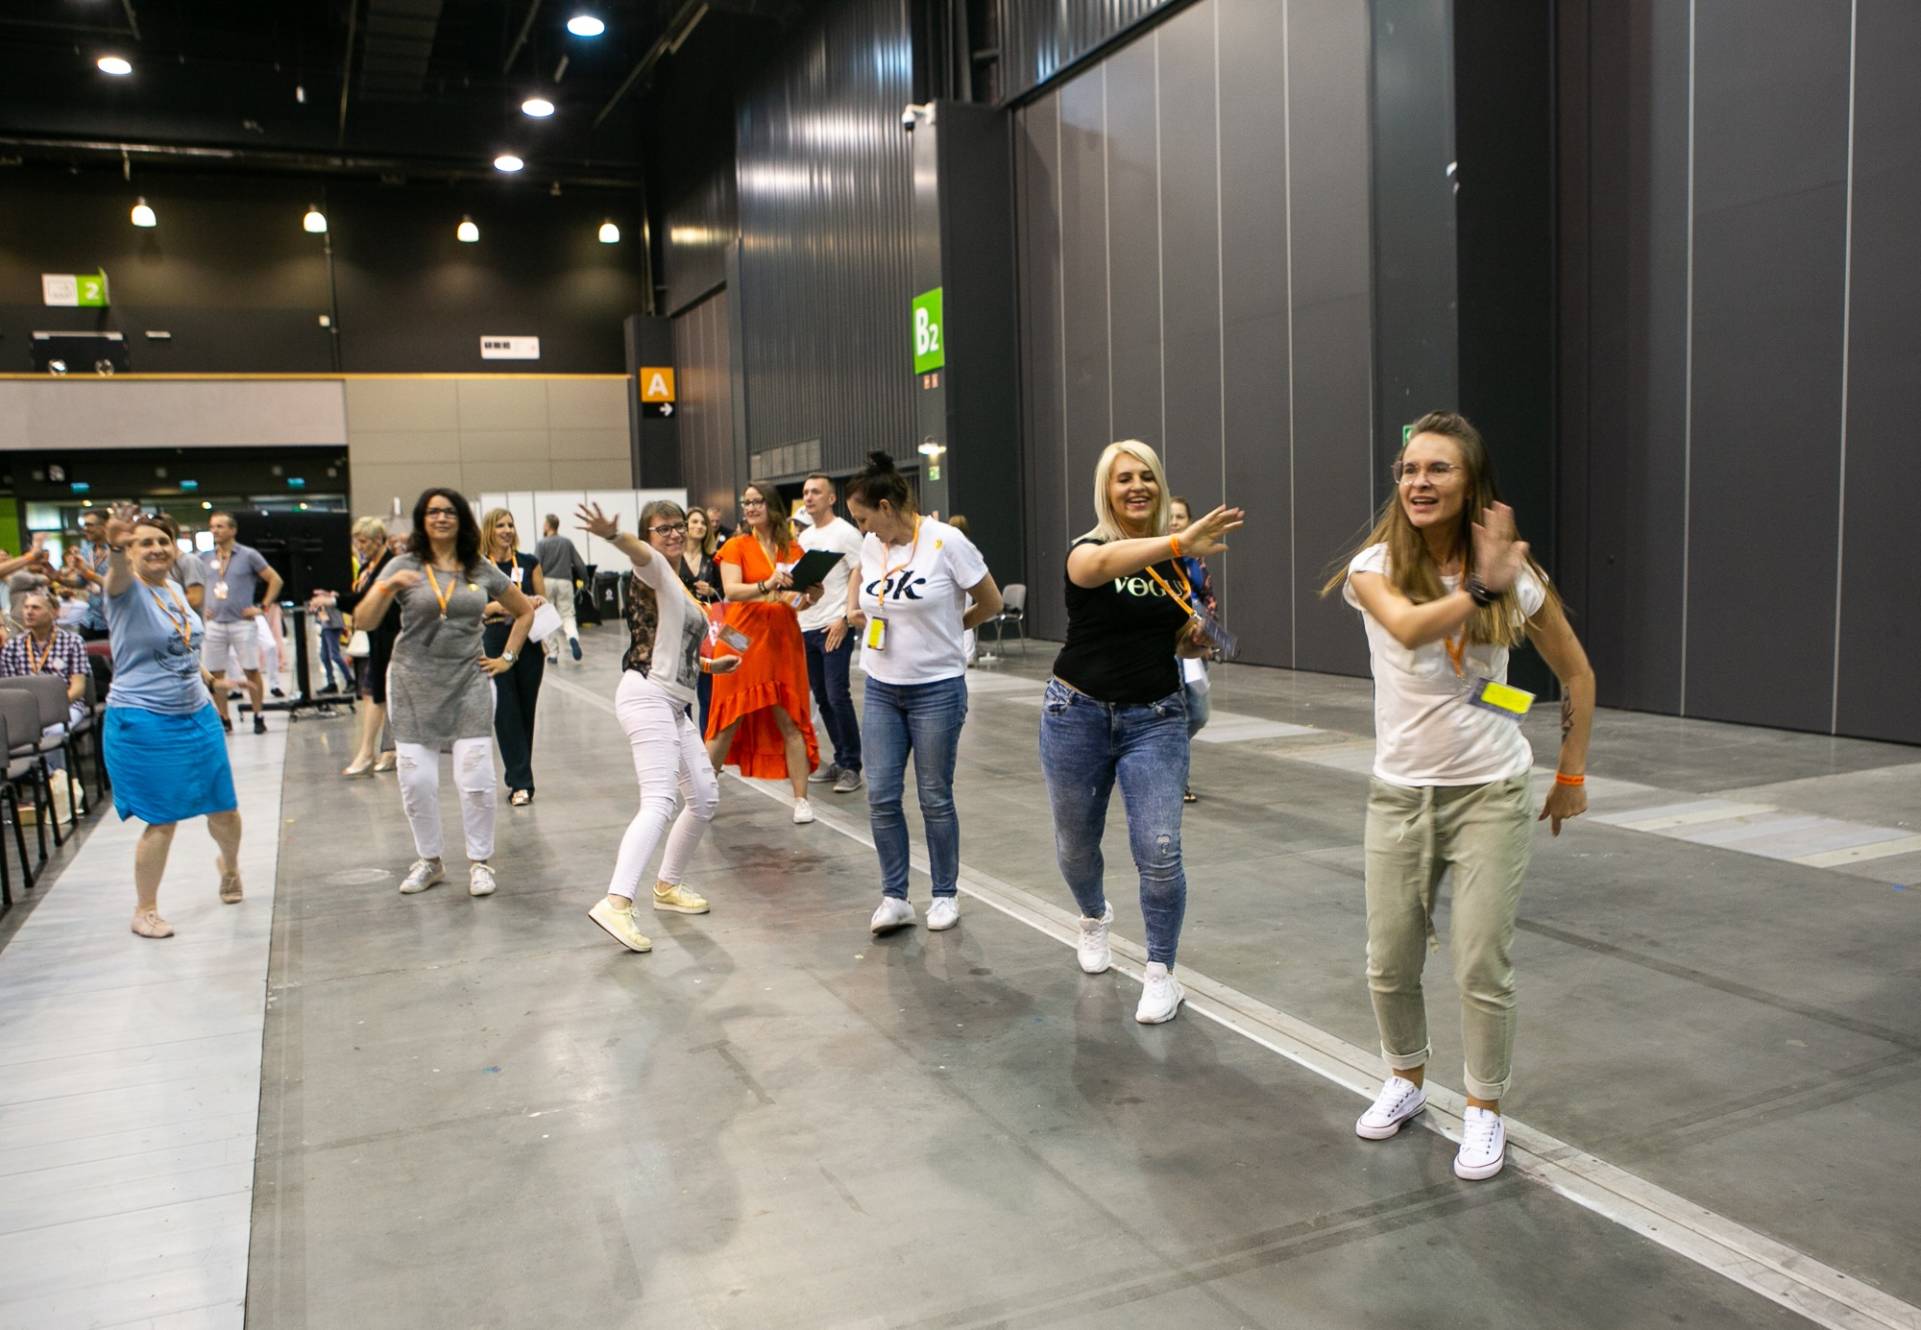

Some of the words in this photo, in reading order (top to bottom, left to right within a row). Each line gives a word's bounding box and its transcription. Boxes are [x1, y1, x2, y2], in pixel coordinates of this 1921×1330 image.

[84, 281, 100, 300] 2
[915, 307, 939, 356] B2
[647, 372, 669, 397] A
